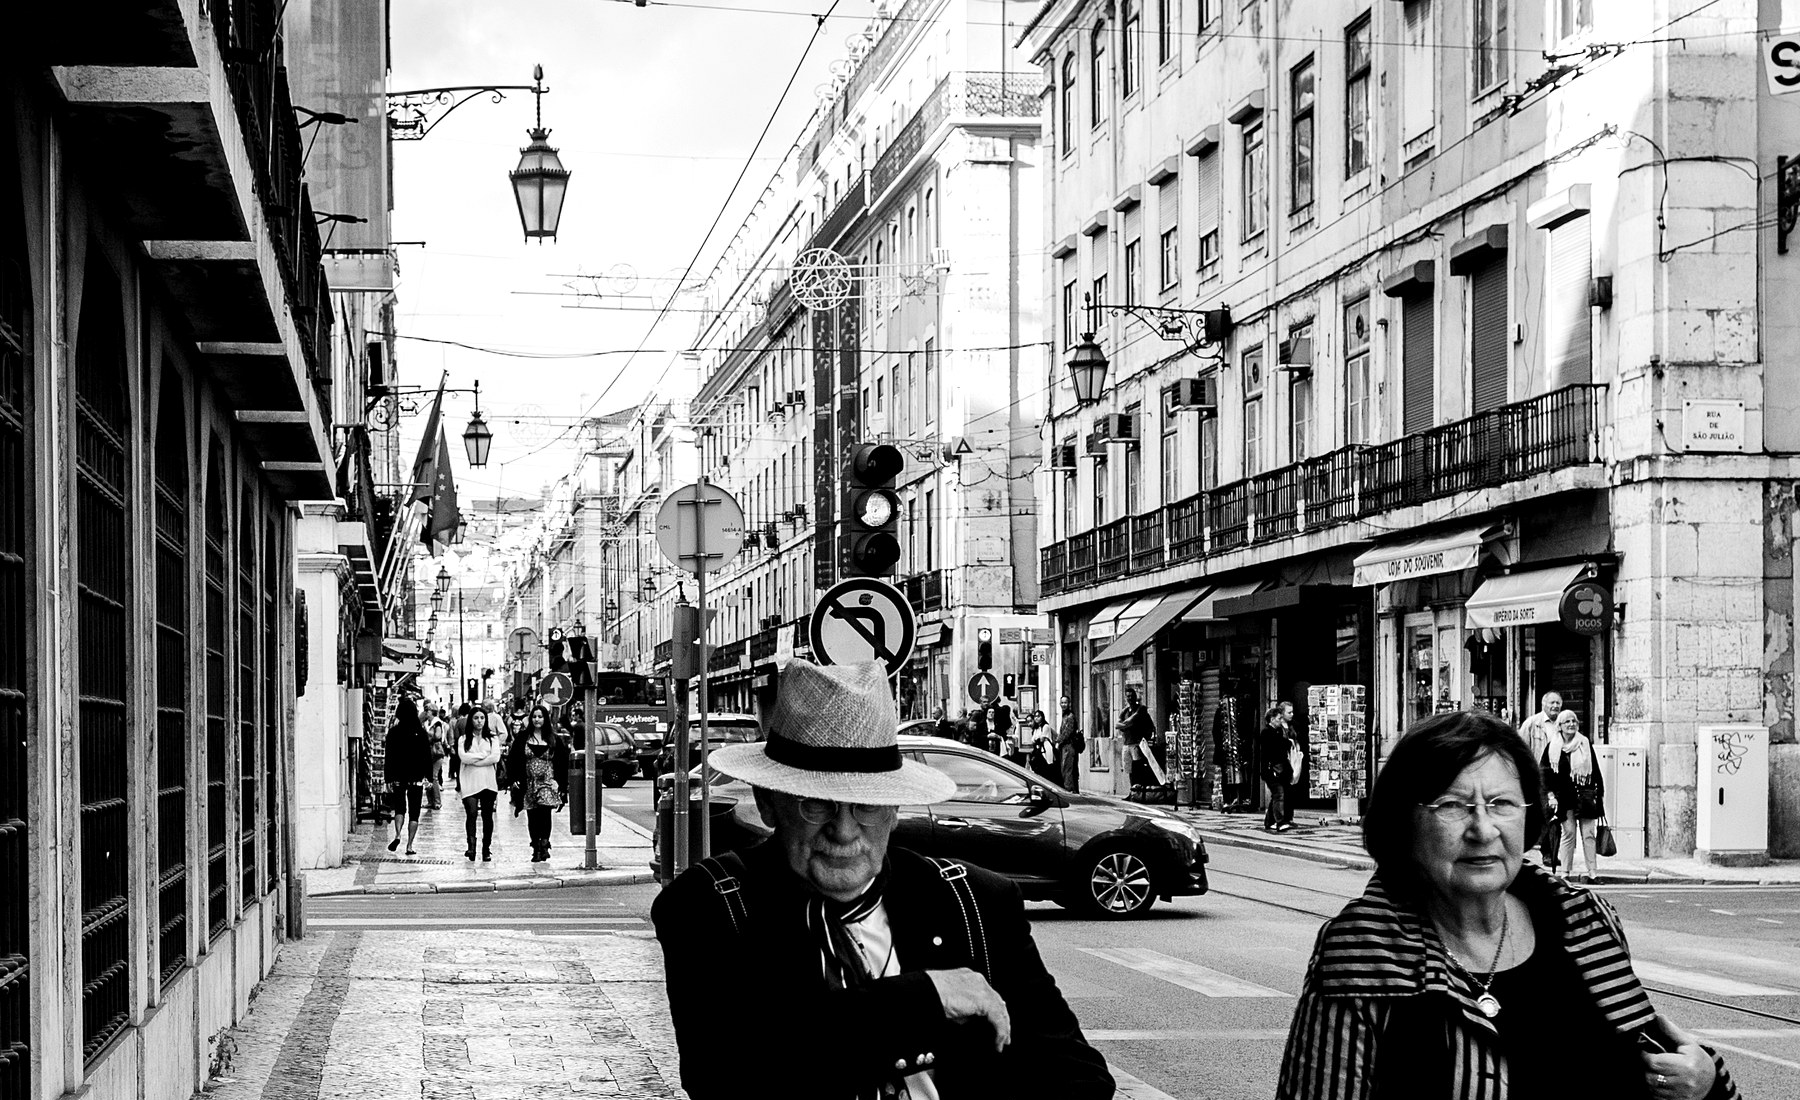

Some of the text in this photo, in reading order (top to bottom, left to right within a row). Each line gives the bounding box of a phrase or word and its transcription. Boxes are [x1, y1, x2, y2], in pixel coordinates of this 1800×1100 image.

[1693, 431, 1735, 440] SÃO JULIÃO
[1388, 552, 1444, 577] LOJA DO SOUVENIR
[1493, 607, 1535, 622] IMPÉRIO DA SORTE
[1575, 618, 1602, 630] JOGOS
[605, 714, 660, 725] Lisbon Sightseeing
